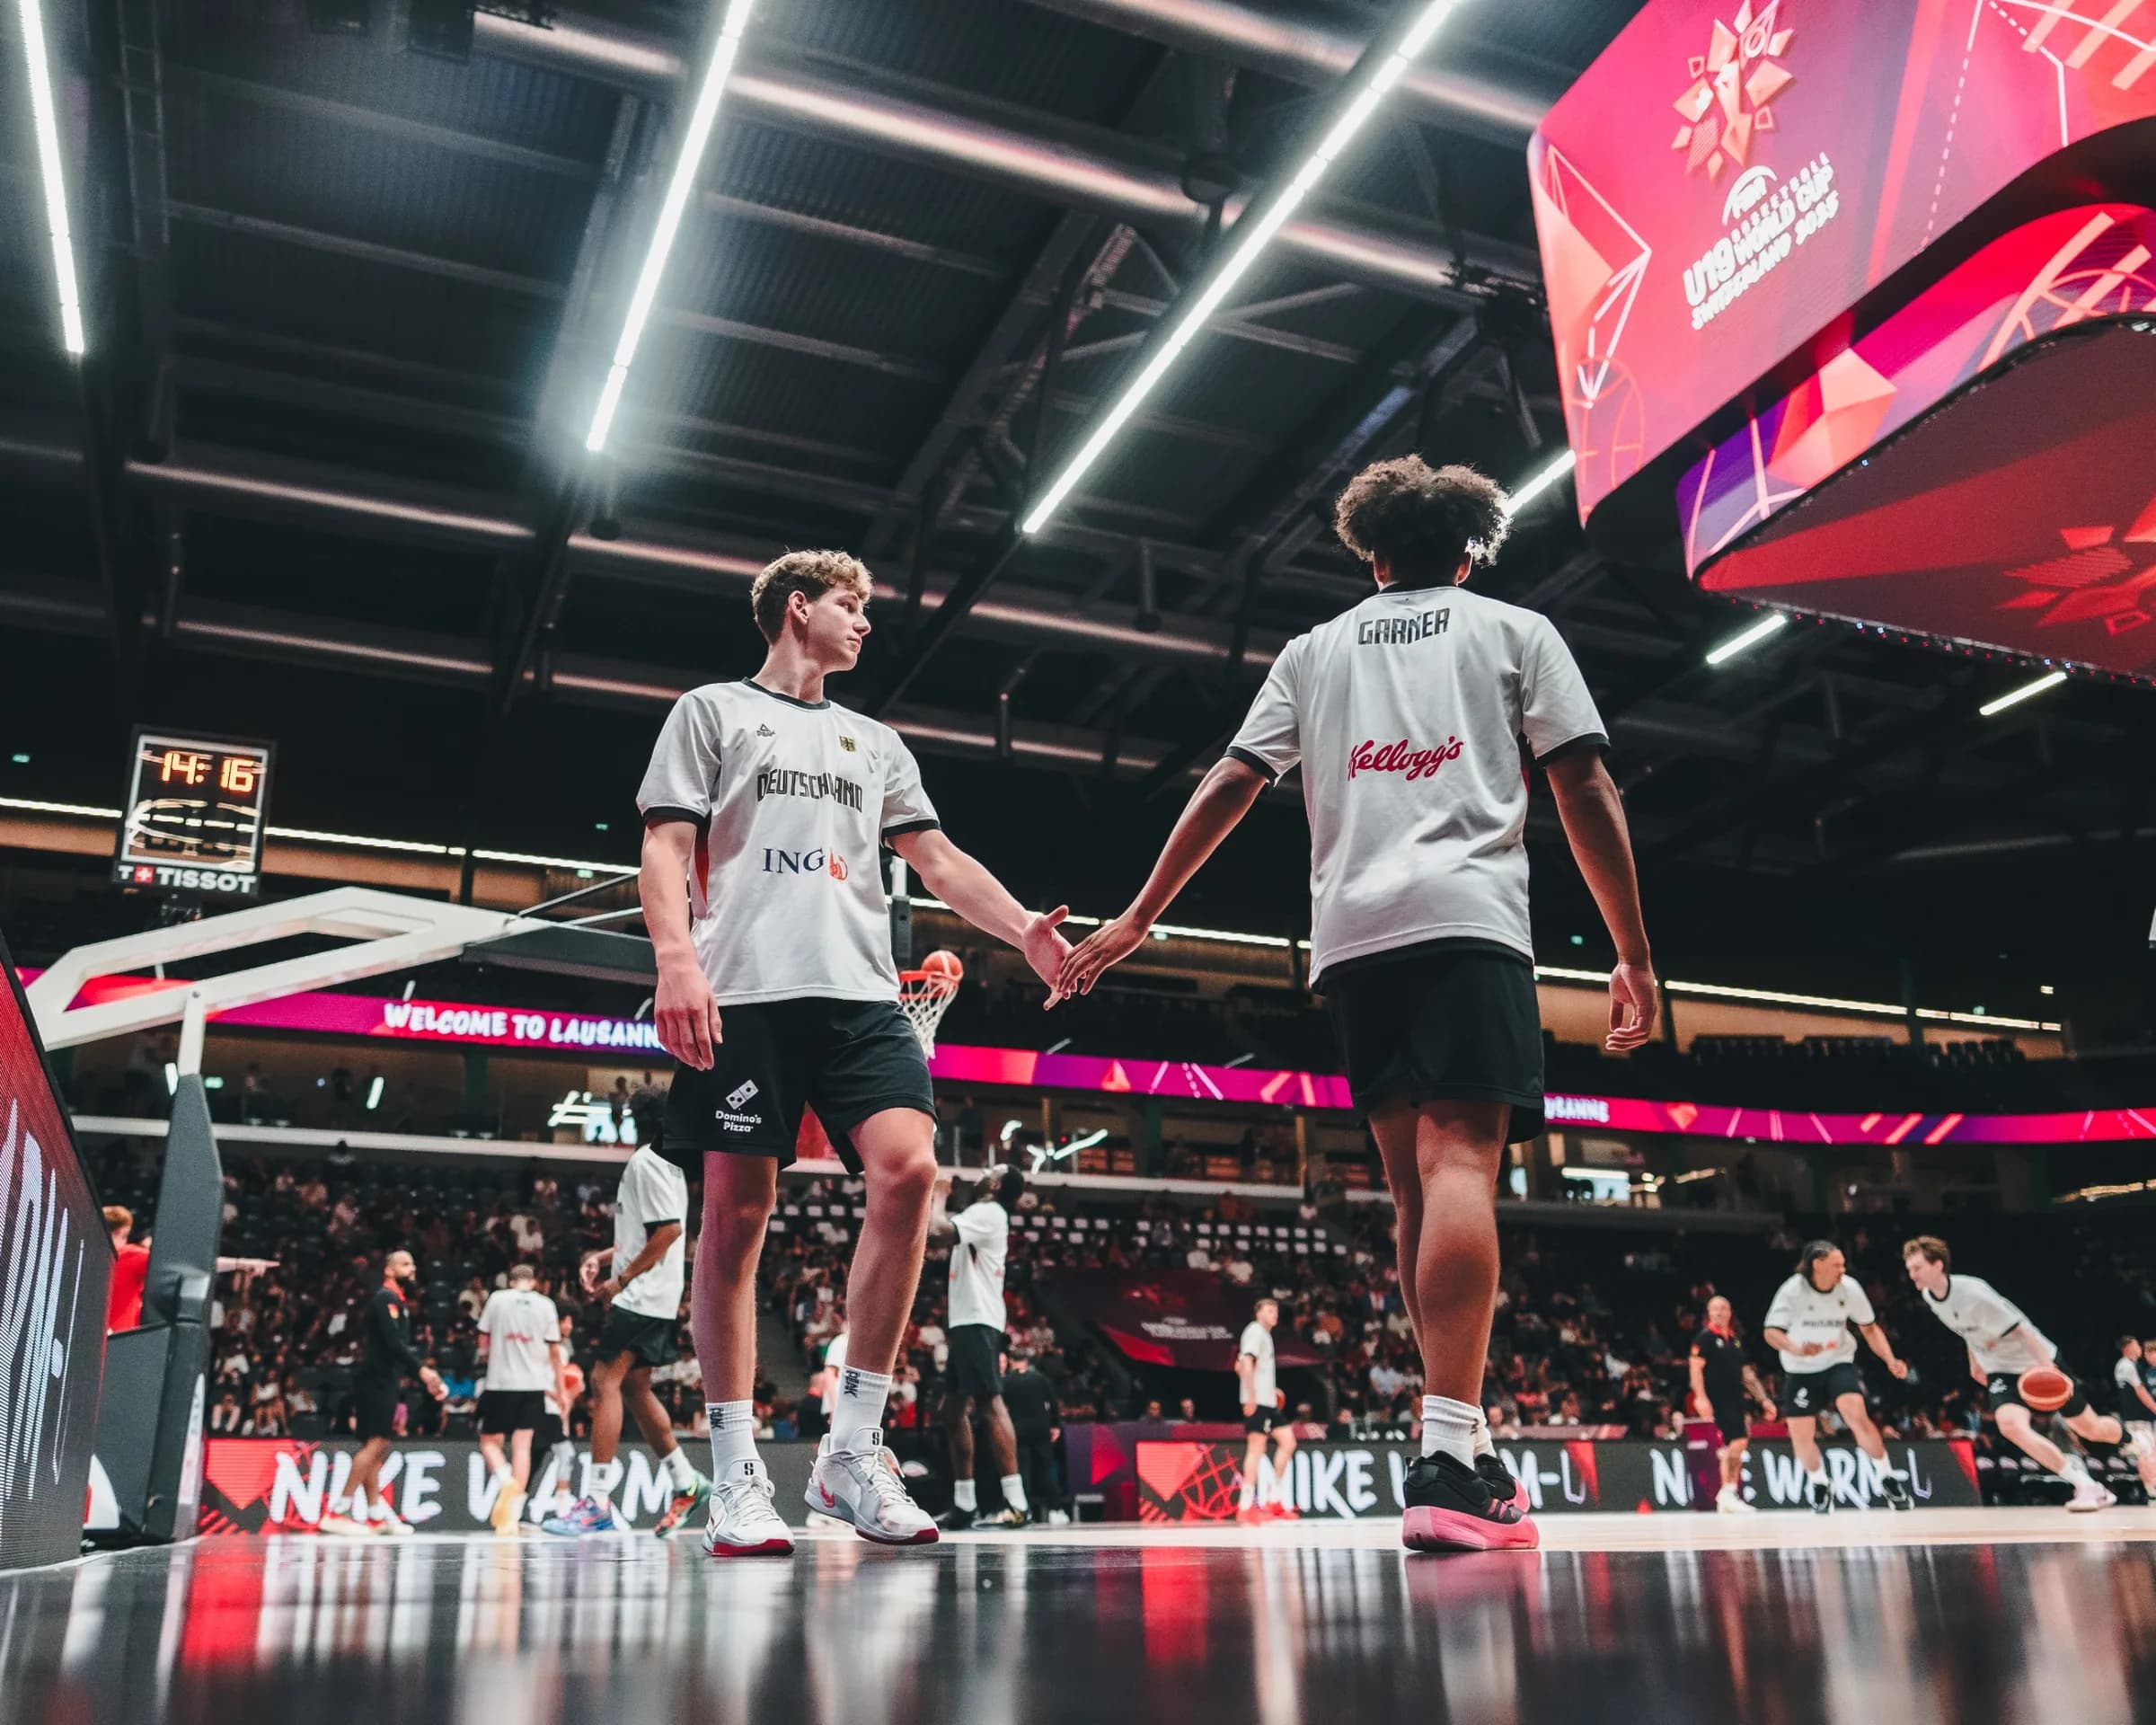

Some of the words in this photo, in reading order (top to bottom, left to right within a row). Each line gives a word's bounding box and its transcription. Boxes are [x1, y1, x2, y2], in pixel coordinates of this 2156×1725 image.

[1683, 237, 1736, 306] U19
[1734, 199, 1796, 266] WORLD
[1795, 164, 1833, 213] CUP
[1357, 607, 1450, 645] GARNER
[1348, 735, 1464, 782] Kellogg's
[756, 768, 863, 814] DEUTSCHLAND
[155, 866, 258, 894] TISSOT
[762, 847, 826, 875] ING
[383, 1002, 508, 1038] WELCOME
[511, 1013, 546, 1040] TO
[549, 1016, 664, 1050] LAUSANN
[715, 1110, 762, 1125] Domino's
[722, 1120, 752, 1133] Pizza
[1543, 1094, 1611, 1124] USANNE
[270, 1449, 447, 1526] NIKE
[1258, 1448, 1378, 1518] NIKE
